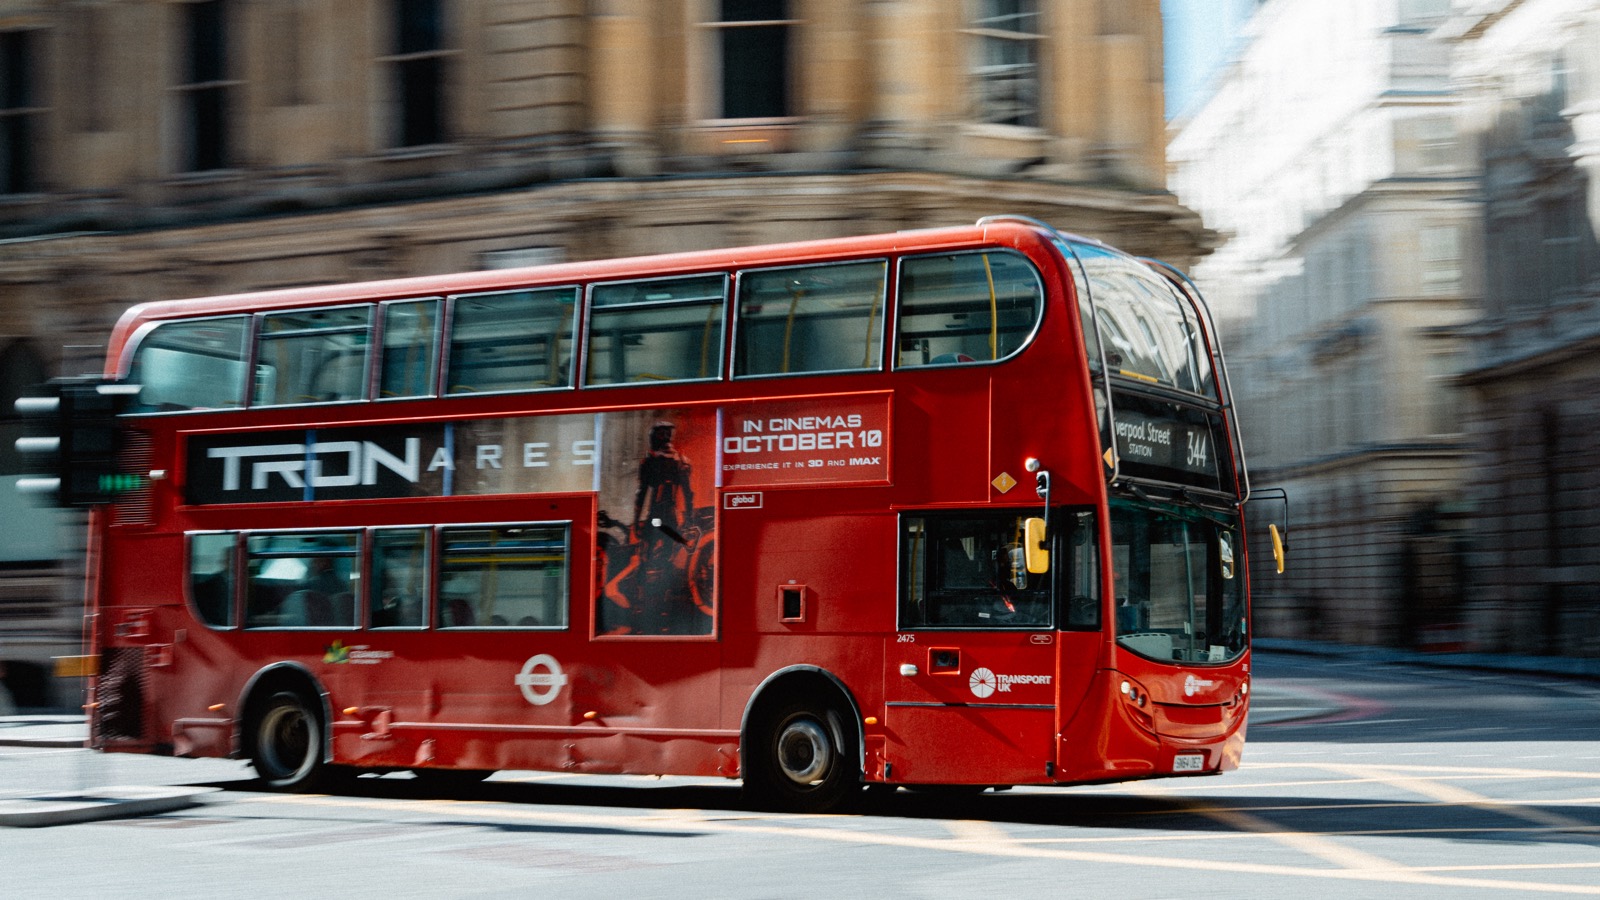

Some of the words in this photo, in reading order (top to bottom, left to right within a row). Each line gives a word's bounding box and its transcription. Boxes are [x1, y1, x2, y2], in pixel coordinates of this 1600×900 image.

[743, 420, 763, 433] IN
[769, 414, 862, 431] CINEMAS
[1115, 420, 1145, 442] verpool
[1147, 422, 1170, 445] Street
[723, 431, 854, 453] OCTOBER
[858, 429, 882, 447] 10
[1129, 443, 1152, 457] STATION
[1187, 431, 1207, 467] 344
[207, 437, 420, 491] TRON
[427, 440, 596, 472] ARES
[722, 462, 779, 471] EXPERIENCE
[808, 459, 823, 467] 3D
[849, 457, 881, 466] IMAX
[731, 495, 755, 507] global
[897, 634, 915, 643] 2475
[996, 674, 1052, 685] TRANSPORT
[997, 684, 1011, 692] UK
